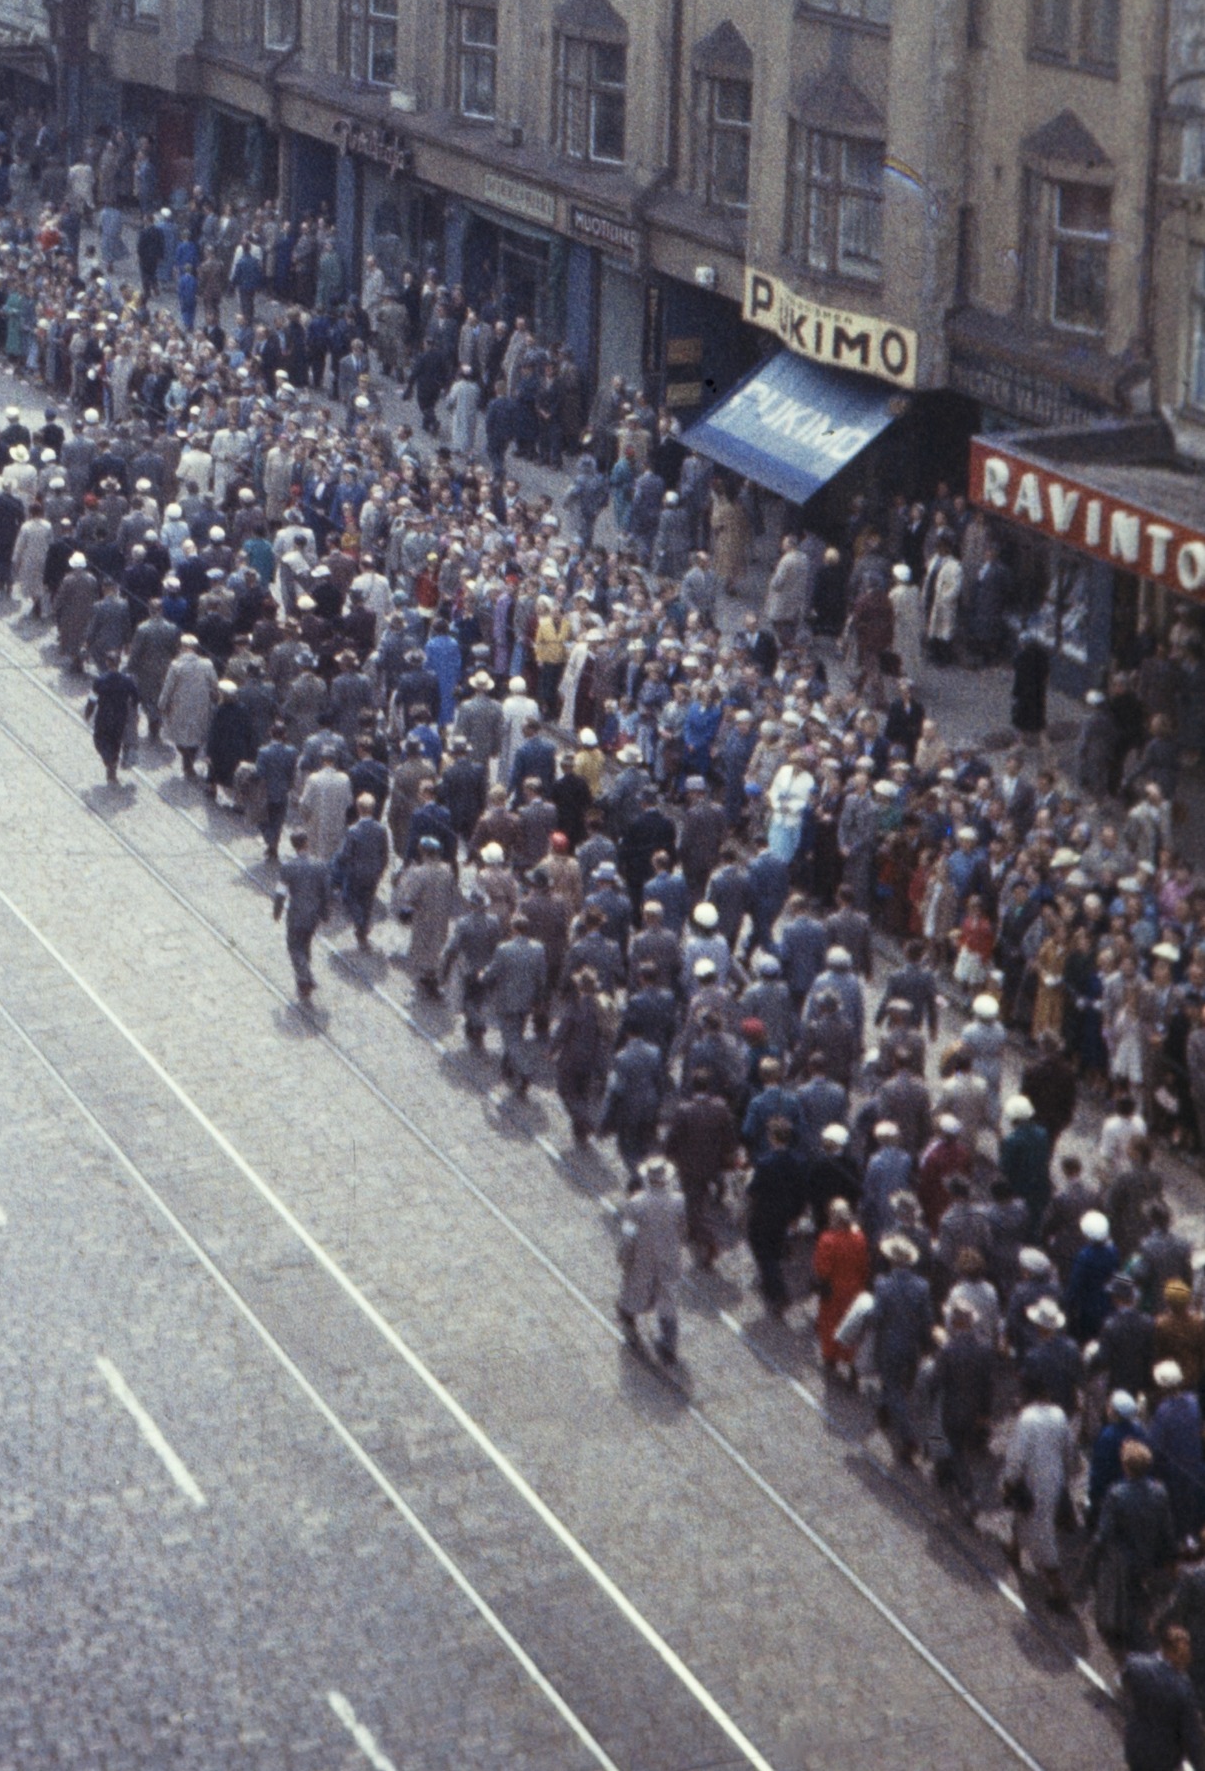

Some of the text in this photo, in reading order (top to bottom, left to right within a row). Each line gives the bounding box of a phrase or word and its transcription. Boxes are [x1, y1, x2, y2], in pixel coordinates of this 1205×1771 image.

[751, 275, 908, 376] PUKIMO
[727, 380, 870, 460] PUKIMO
[984, 457, 1205, 591] RAVINTO
